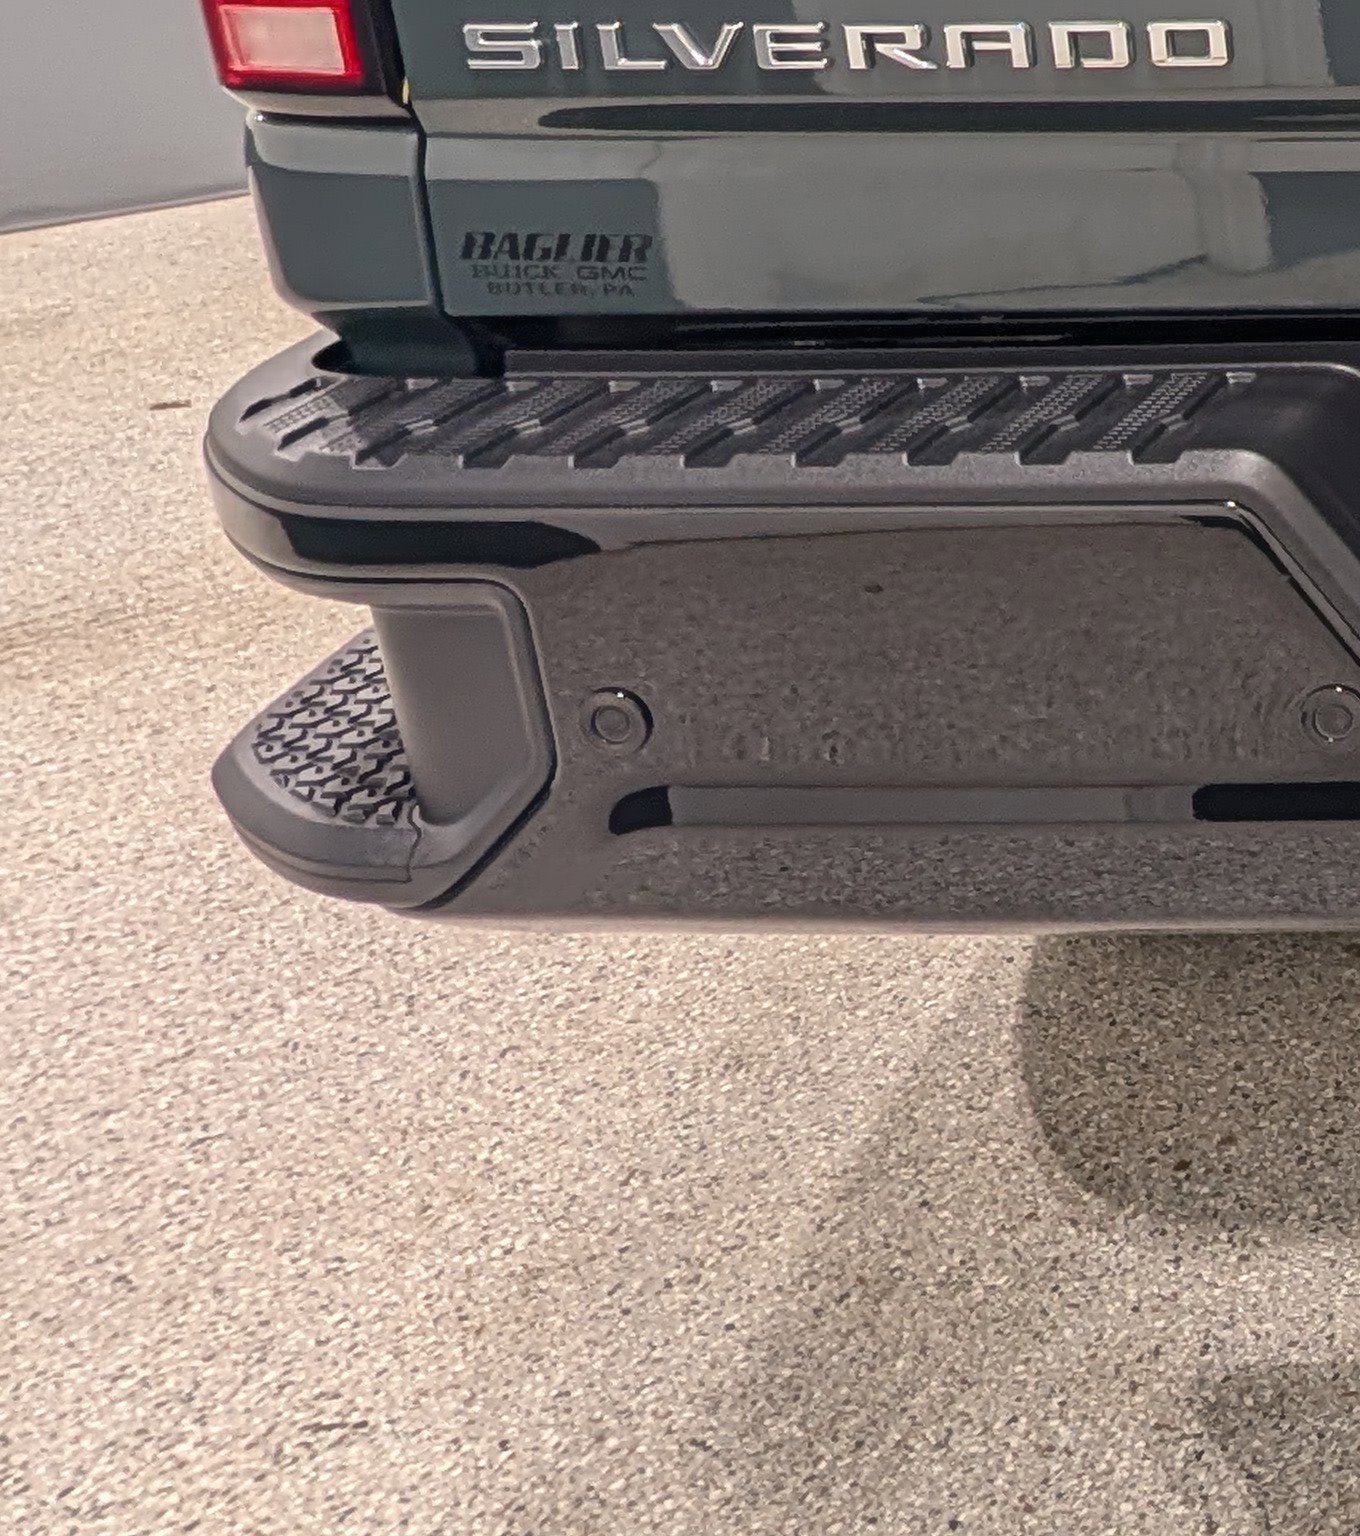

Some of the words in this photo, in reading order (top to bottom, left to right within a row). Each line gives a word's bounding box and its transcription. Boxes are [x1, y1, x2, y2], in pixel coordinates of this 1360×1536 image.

[462, 20, 1233, 70] SILVERADO
[471, 264, 559, 279] BUICK
[577, 266, 648, 281] GMC
